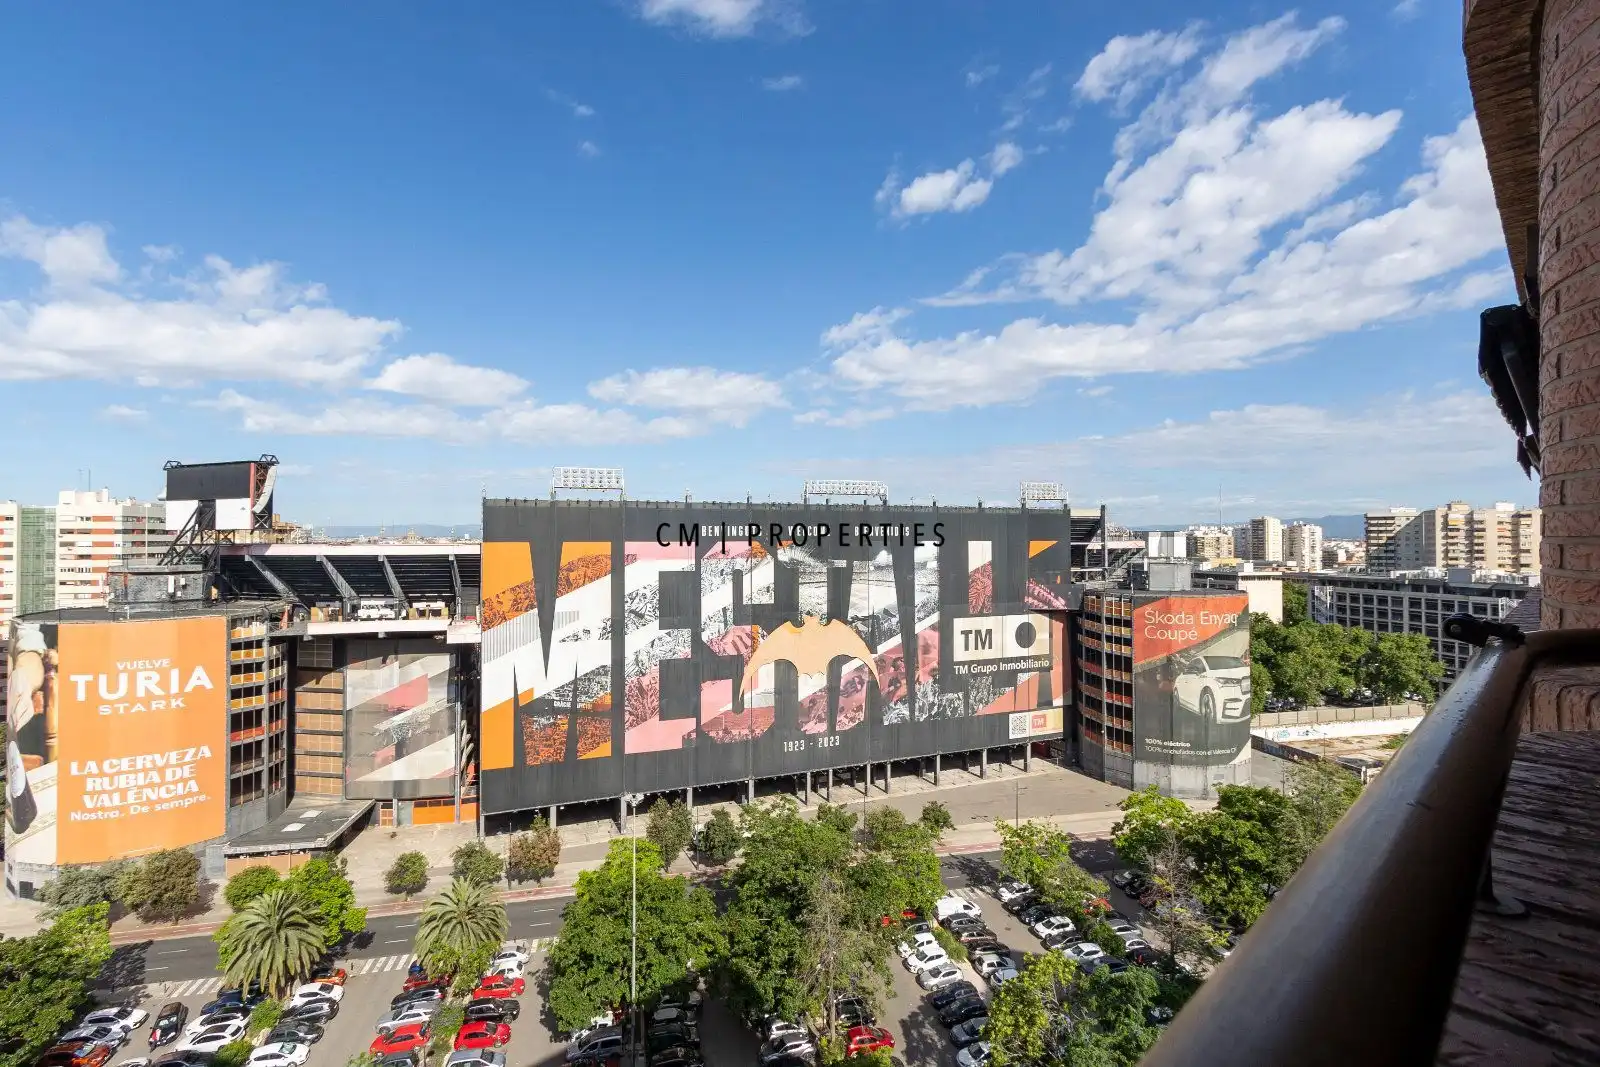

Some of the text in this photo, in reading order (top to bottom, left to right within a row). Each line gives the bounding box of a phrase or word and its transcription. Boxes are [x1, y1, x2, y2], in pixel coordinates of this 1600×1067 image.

[1144, 607, 1238, 627] Škoda Enyaq
[961, 628, 992, 651] TM
[1144, 626, 1198, 644] Coupé
[116, 658, 171, 671] VUELVE
[954, 658, 1050, 675] TM Grupo Inmobiliario
[69, 665, 214, 702] TURIA
[98, 697, 187, 716] STARK
[1033, 717, 1044, 727] TM
[783, 739, 805, 753] 1923
[818, 735, 840, 748] 2023
[70, 744, 212, 776] LA CERVEZA
[85, 763, 197, 792] RUBIA DE
[129, 805, 150, 815] De
